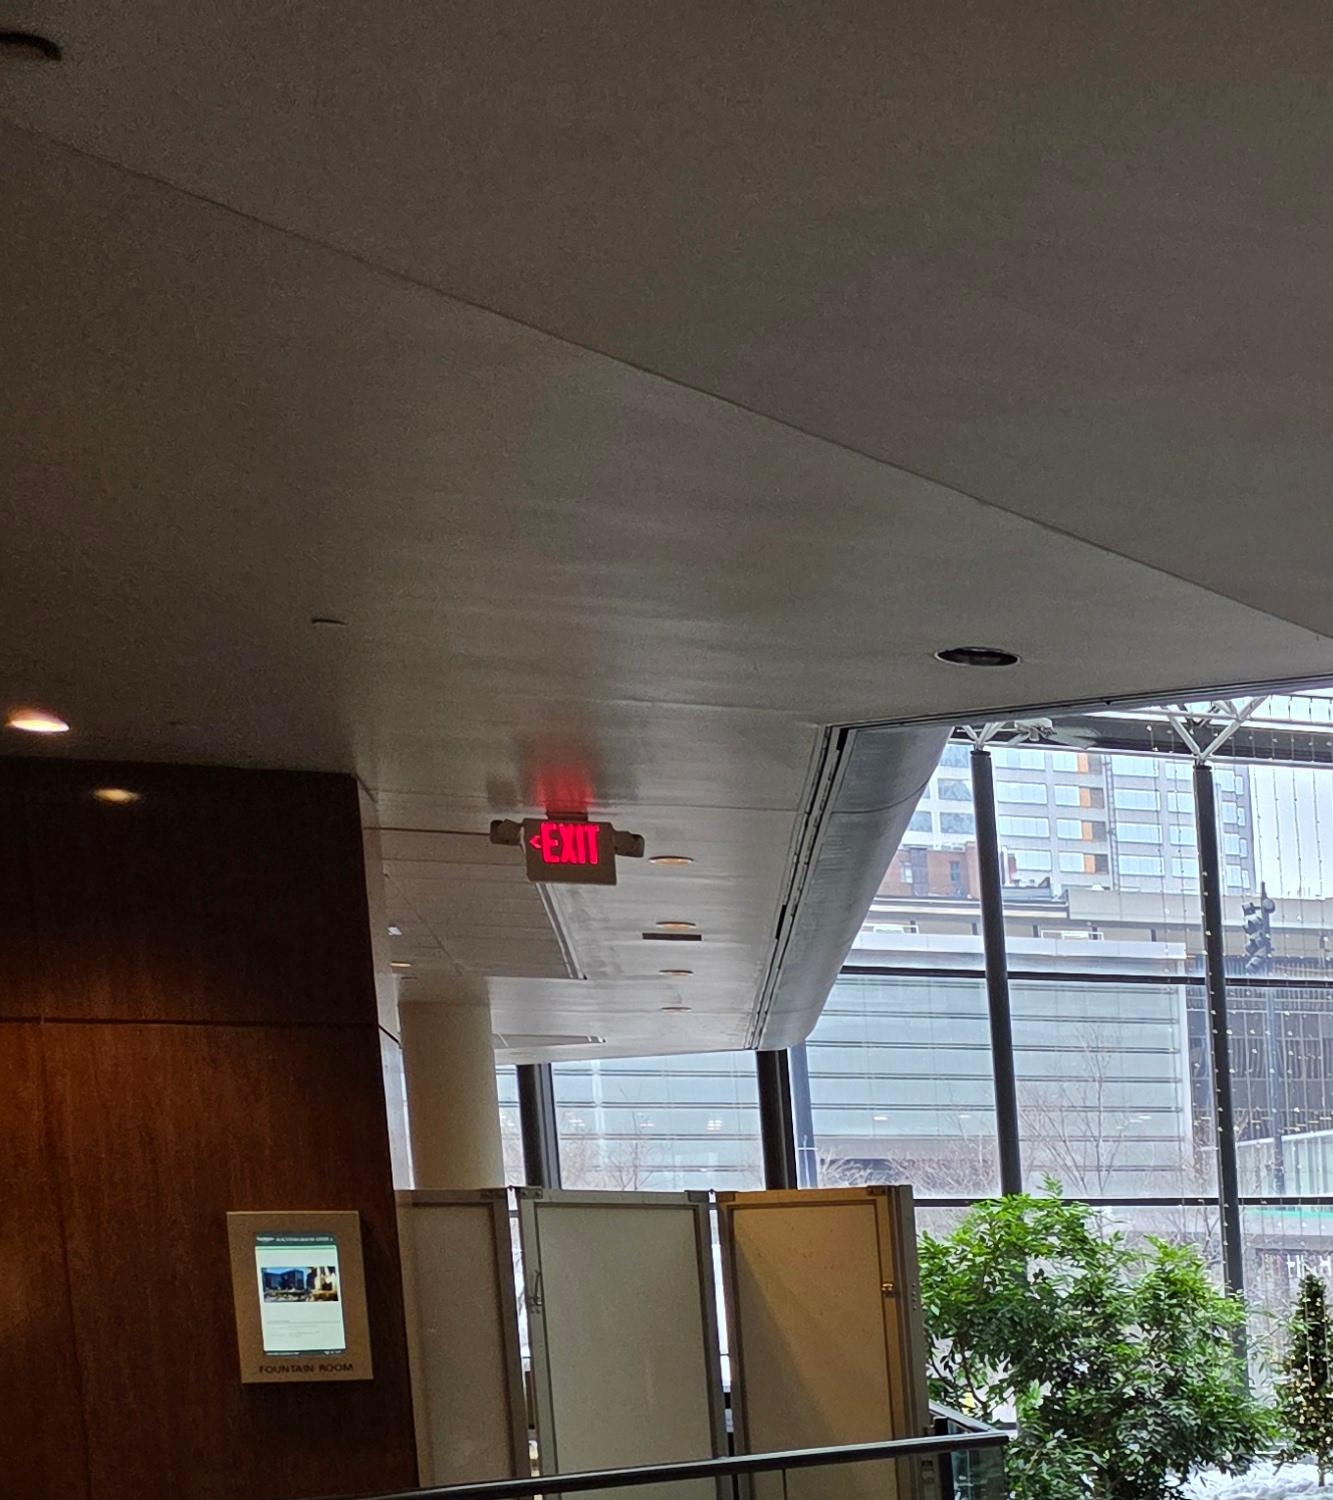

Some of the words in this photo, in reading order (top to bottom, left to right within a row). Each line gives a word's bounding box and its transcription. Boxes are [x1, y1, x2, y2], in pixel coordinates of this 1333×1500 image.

[541, 821, 600, 865] EXIT
[259, 1364, 314, 1374] FOUNTAIN
[318, 1363, 353, 1373] ROOM
